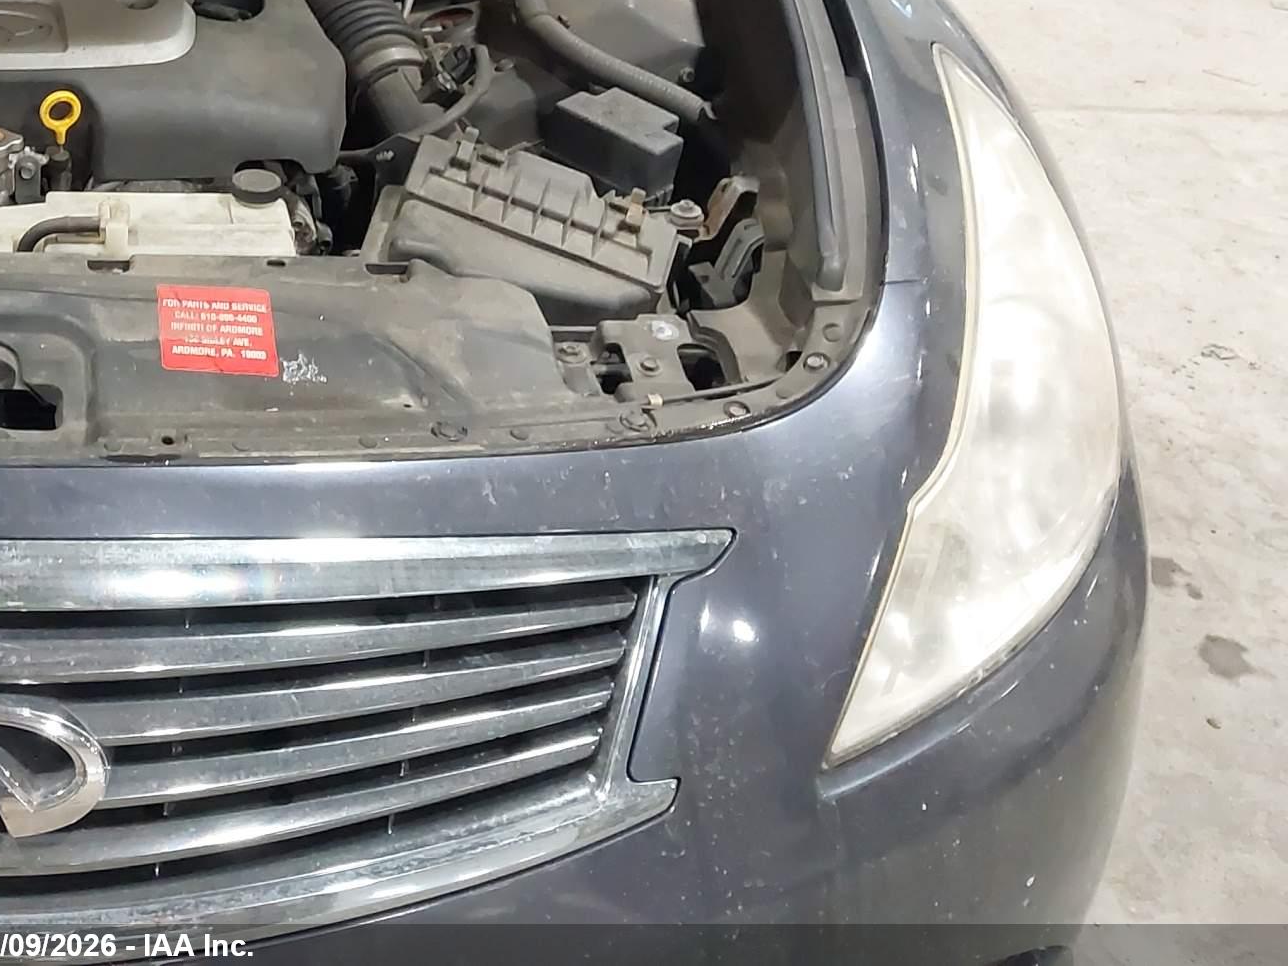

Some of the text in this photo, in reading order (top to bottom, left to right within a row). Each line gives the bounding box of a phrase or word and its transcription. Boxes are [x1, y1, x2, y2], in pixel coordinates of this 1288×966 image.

[162, 298, 267, 314] FOR PARTS AND SERVICE
[206, 323, 218, 333] OF
[219, 324, 263, 336] ARDMORE
